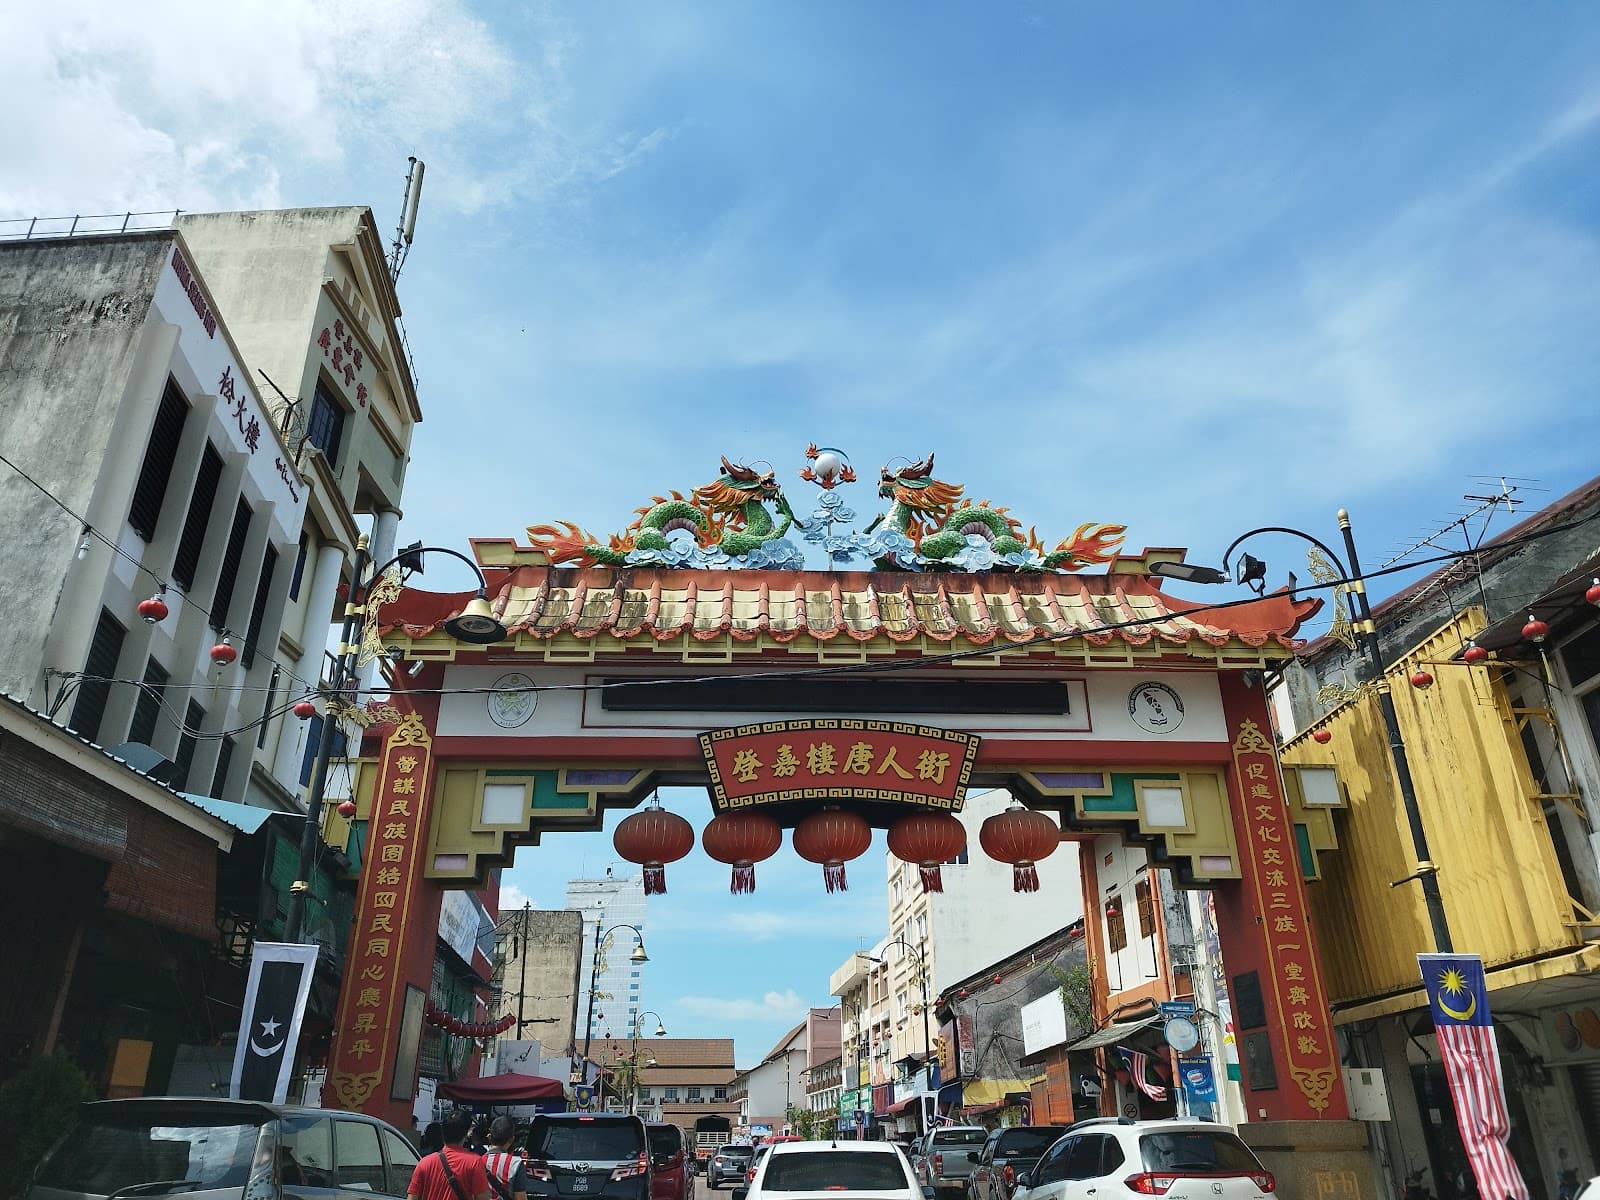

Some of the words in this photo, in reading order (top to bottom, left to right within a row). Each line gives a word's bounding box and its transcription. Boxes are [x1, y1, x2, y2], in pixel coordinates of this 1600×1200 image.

[731, 741, 951, 785] 登嘉樓唐人街
